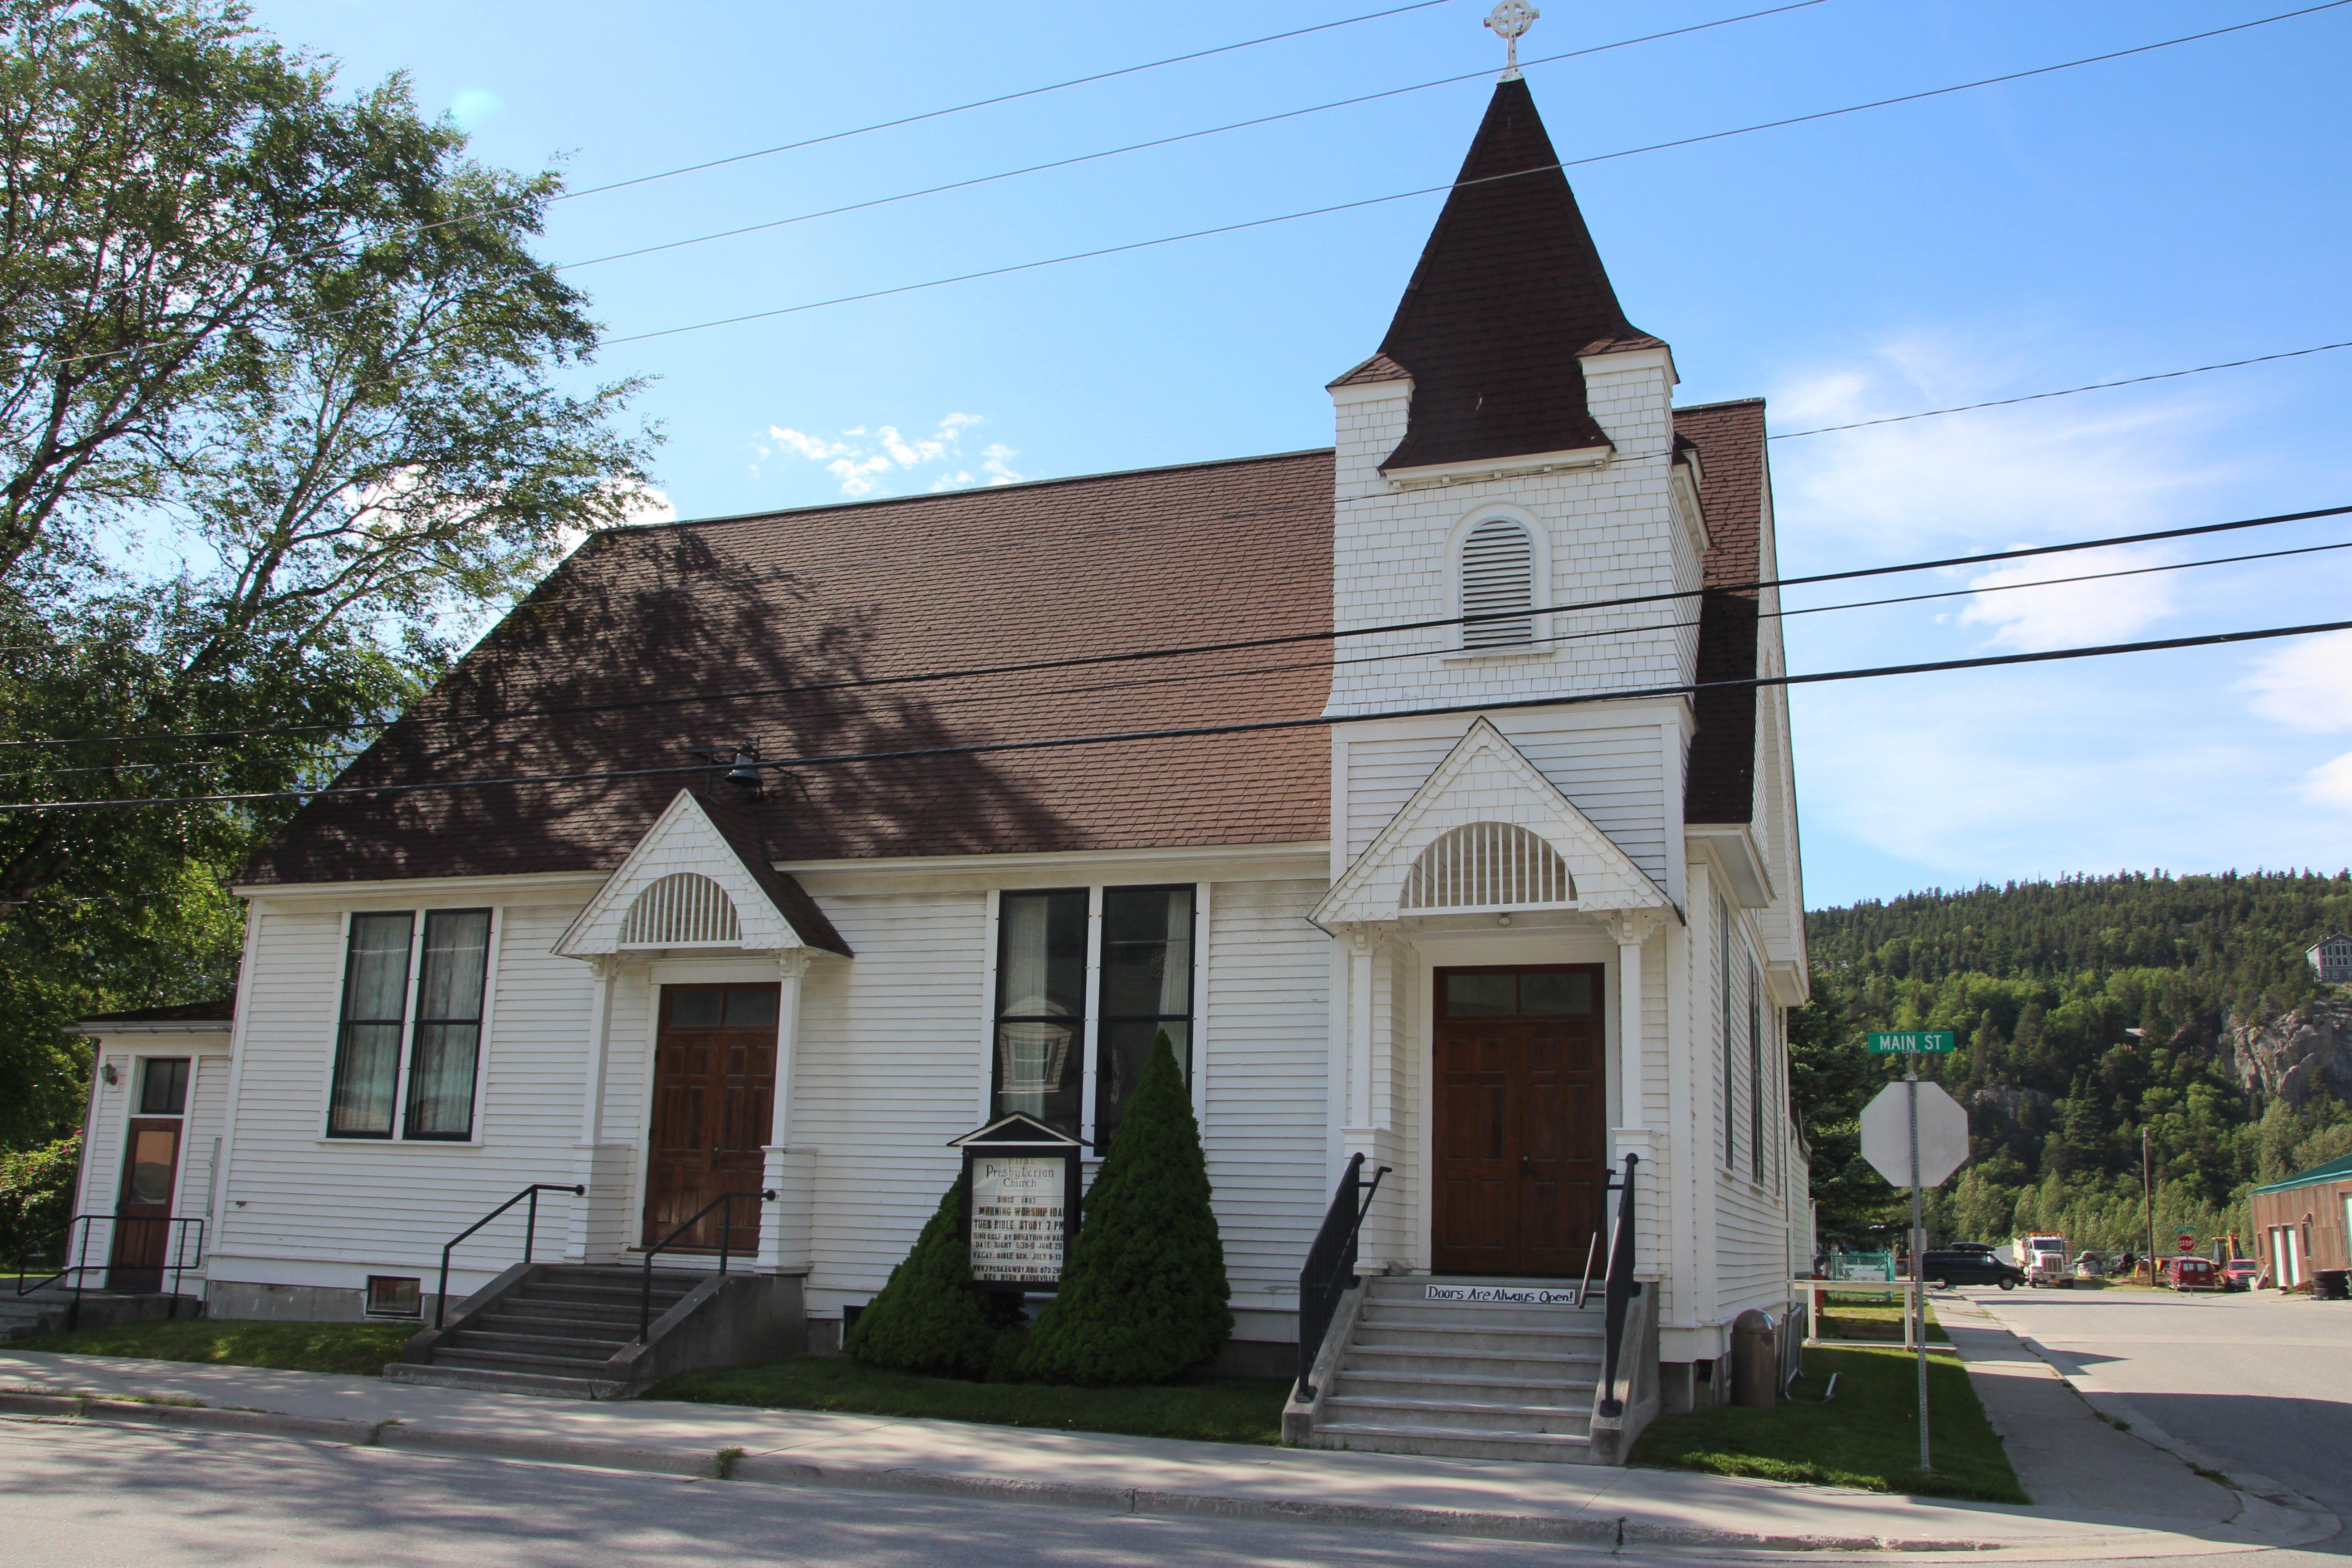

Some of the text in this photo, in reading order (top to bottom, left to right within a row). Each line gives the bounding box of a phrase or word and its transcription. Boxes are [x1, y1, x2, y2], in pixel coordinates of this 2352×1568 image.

[1880, 1034, 1942, 1050] MAIN ST
[986, 1165, 1054, 1179] Presbyterian
[1003, 1178, 1037, 1187] Church
[979, 1207, 1064, 1217] MORNING WORSHIP 10A
[974, 1220, 1064, 1230] TUES BIBLE STUDY 7 PM
[1428, 1286, 1573, 1304] Doors Are Always Open!
